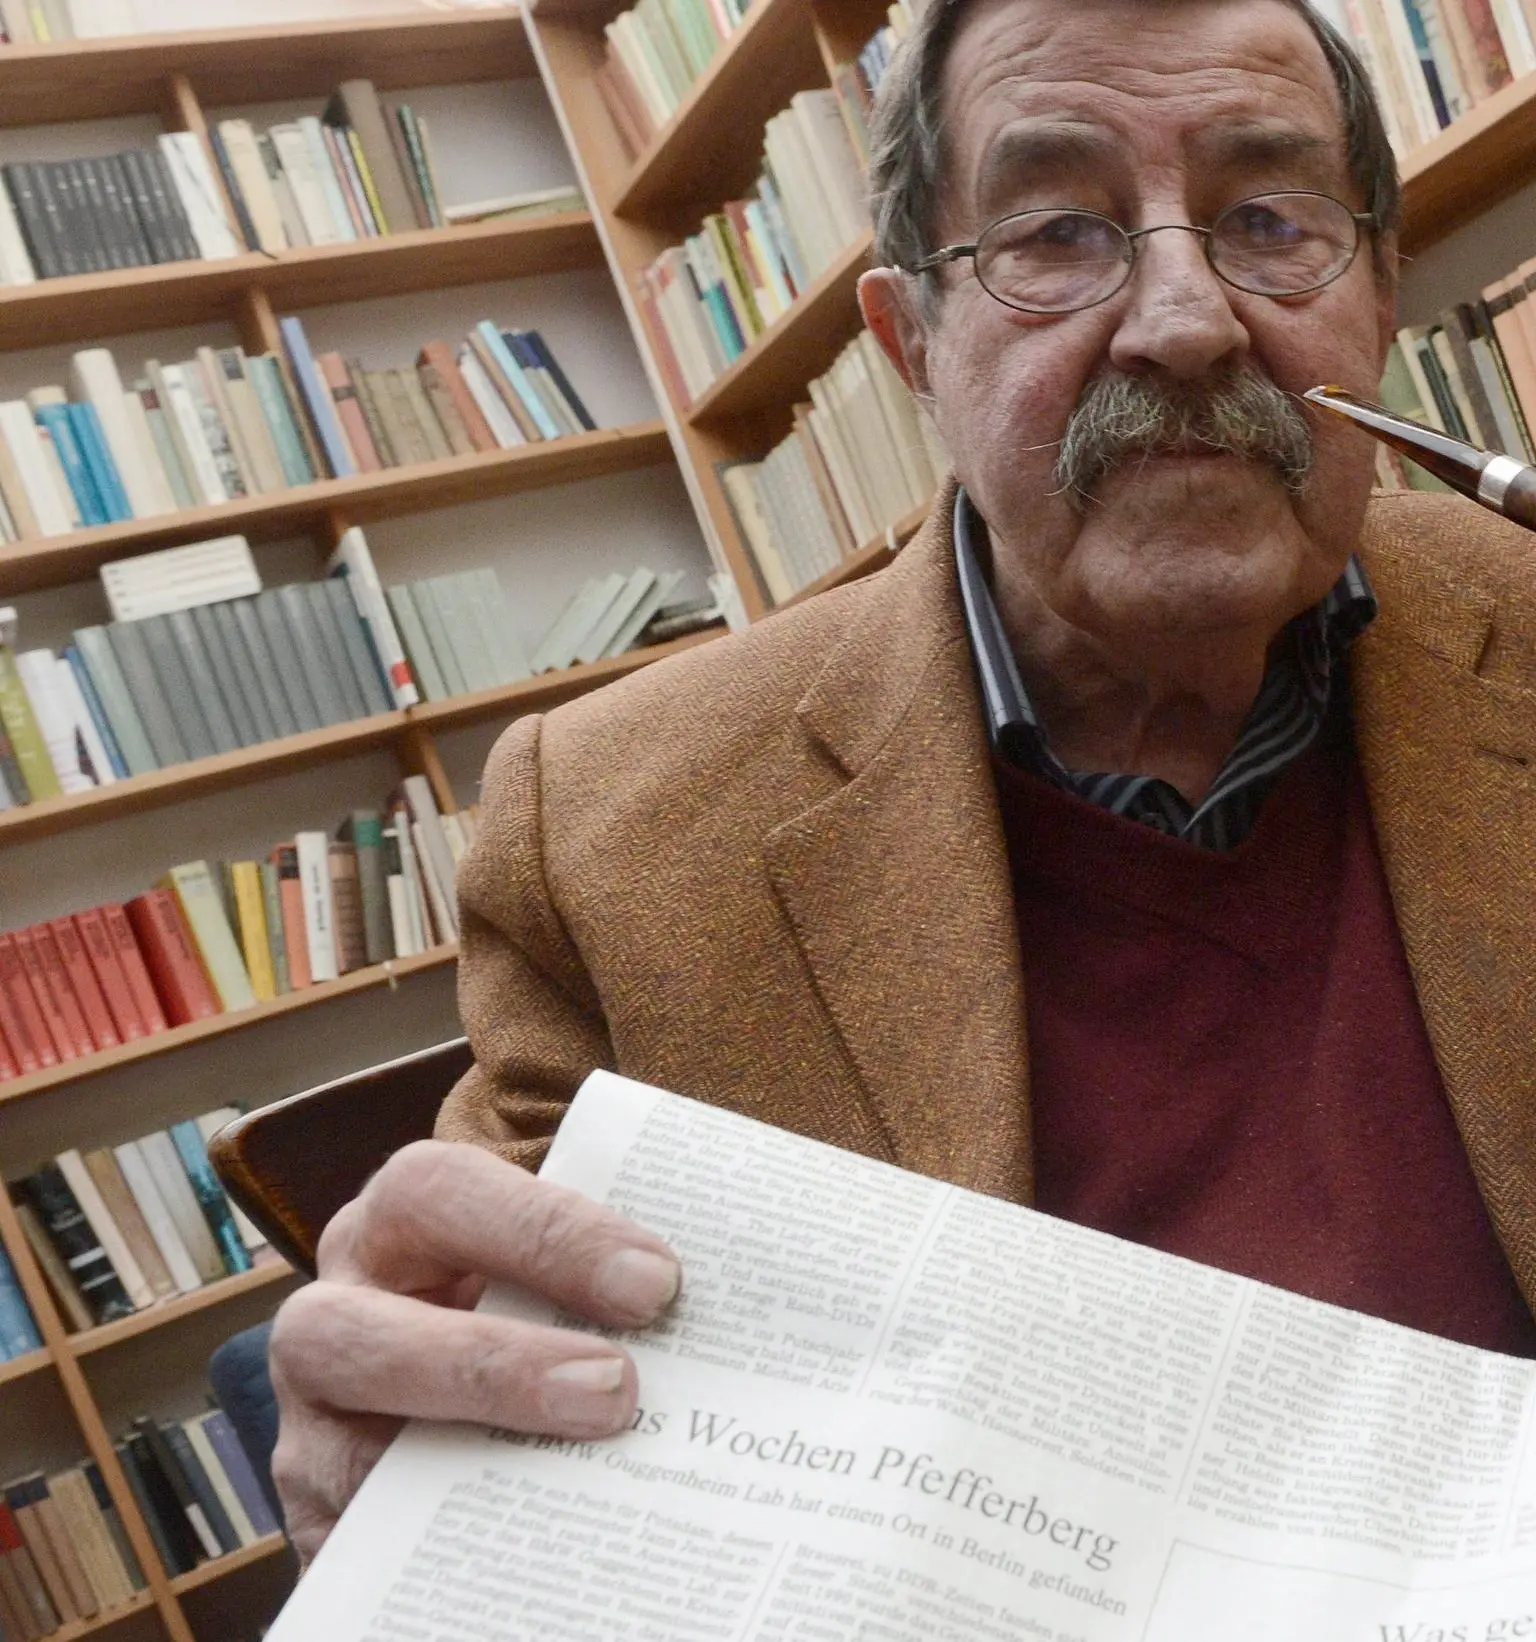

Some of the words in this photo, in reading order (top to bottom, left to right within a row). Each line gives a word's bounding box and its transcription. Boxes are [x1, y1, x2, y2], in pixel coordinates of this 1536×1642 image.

[536, 1434, 600, 1461] BMW
[605, 1448, 739, 1499] Guggenheim
[742, 1482, 785, 1508] Lab
[788, 1492, 824, 1515] hat
[826, 1503, 885, 1528] einen
[892, 1512, 929, 1539] Ort
[931, 1528, 956, 1549] in
[959, 1537, 1026, 1579] Berlin
[1028, 1567, 1128, 1617] gefunden
[688, 1407, 857, 1476] Wochen
[869, 1444, 1120, 1572] Pfefferberg
[1379, 1621, 1468, 1642] Was
